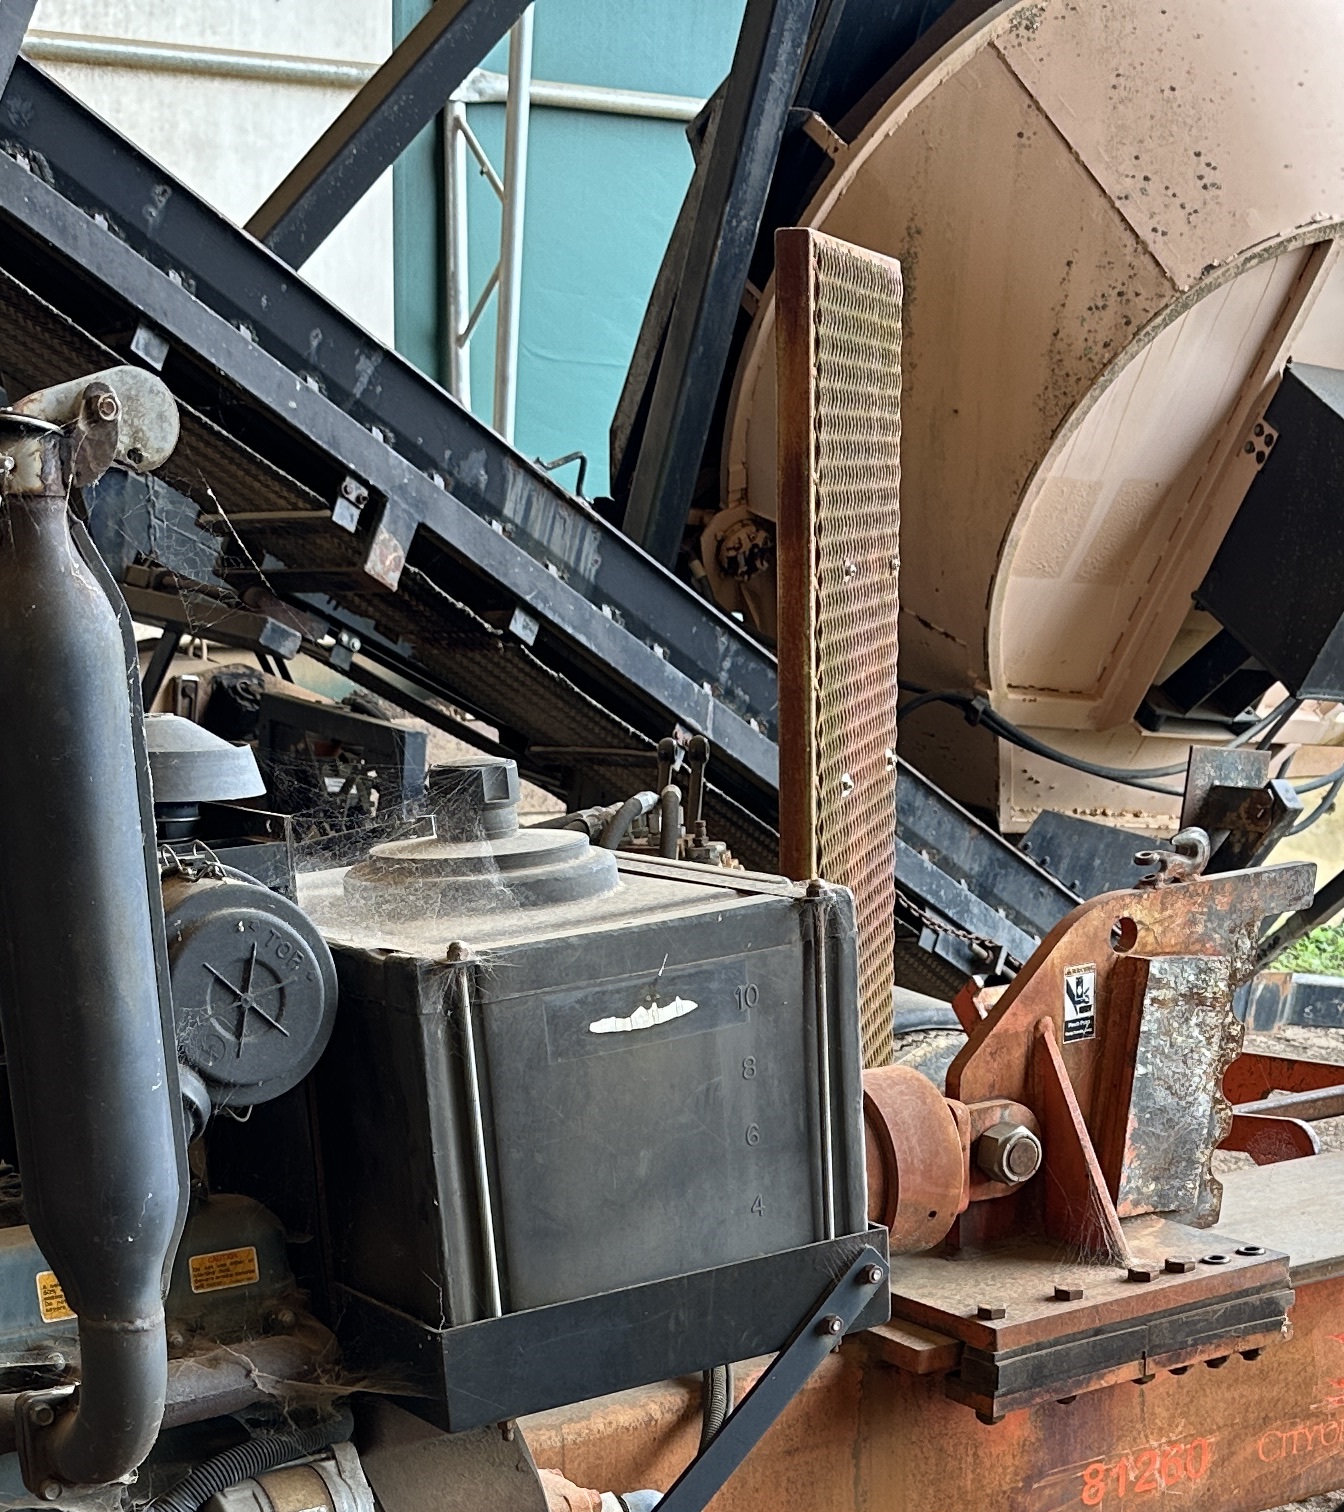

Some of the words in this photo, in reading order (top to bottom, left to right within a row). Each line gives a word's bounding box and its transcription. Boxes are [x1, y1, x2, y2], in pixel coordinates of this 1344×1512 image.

[265, 929, 304, 971] TOP
[734, 983, 759, 1011] 10
[742, 1055, 756, 1080] 8
[746, 1123, 760, 1147] 6
[751, 1193, 766, 1217] 4
[1258, 1423, 1320, 1463] CITY
[1081, 1437, 1208, 1506] 81260
